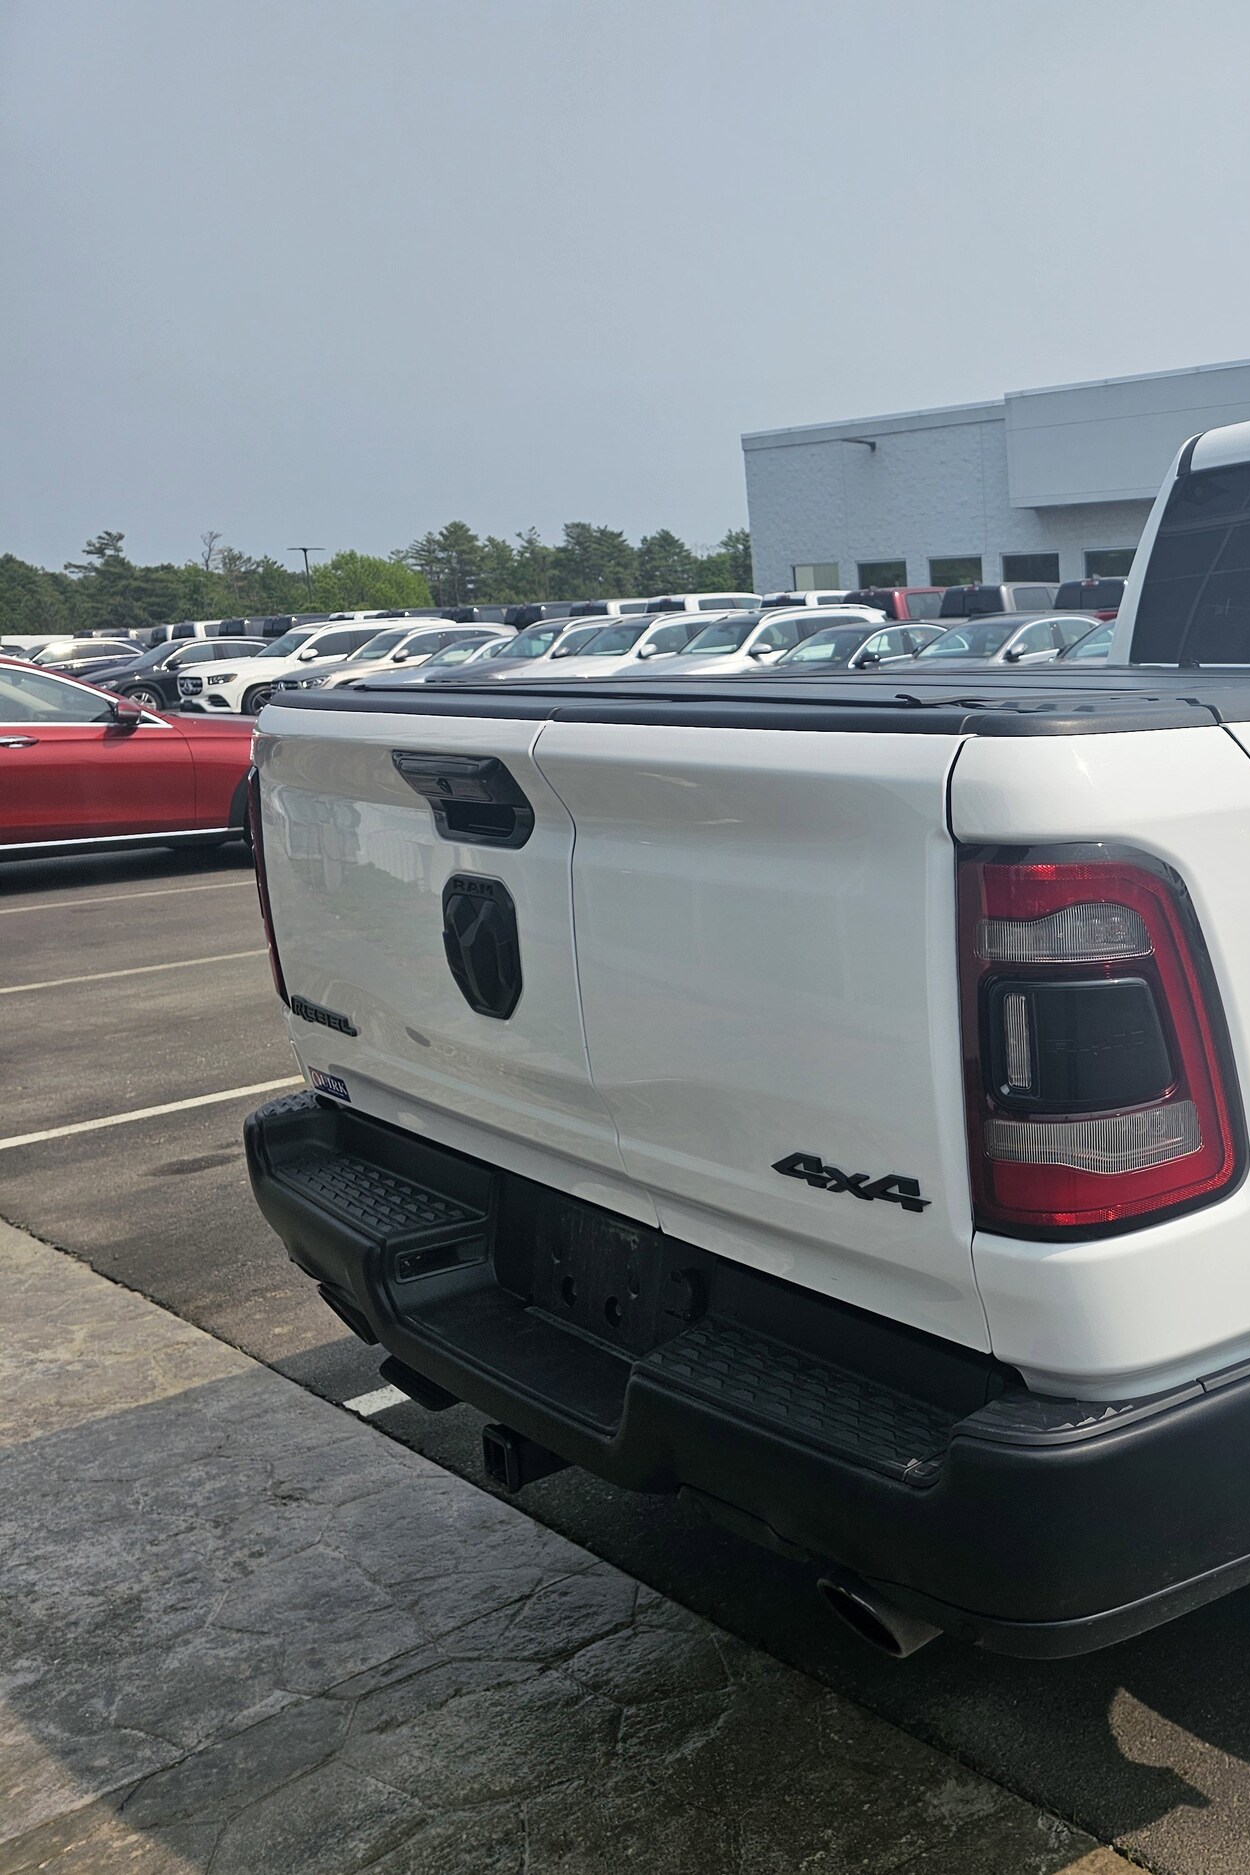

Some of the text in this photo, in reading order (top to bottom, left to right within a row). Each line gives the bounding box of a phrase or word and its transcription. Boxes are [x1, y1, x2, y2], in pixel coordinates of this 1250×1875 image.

[453, 879, 494, 896] RAM
[291, 995, 358, 1037] REBEL
[311, 1070, 348, 1095] QUIRK
